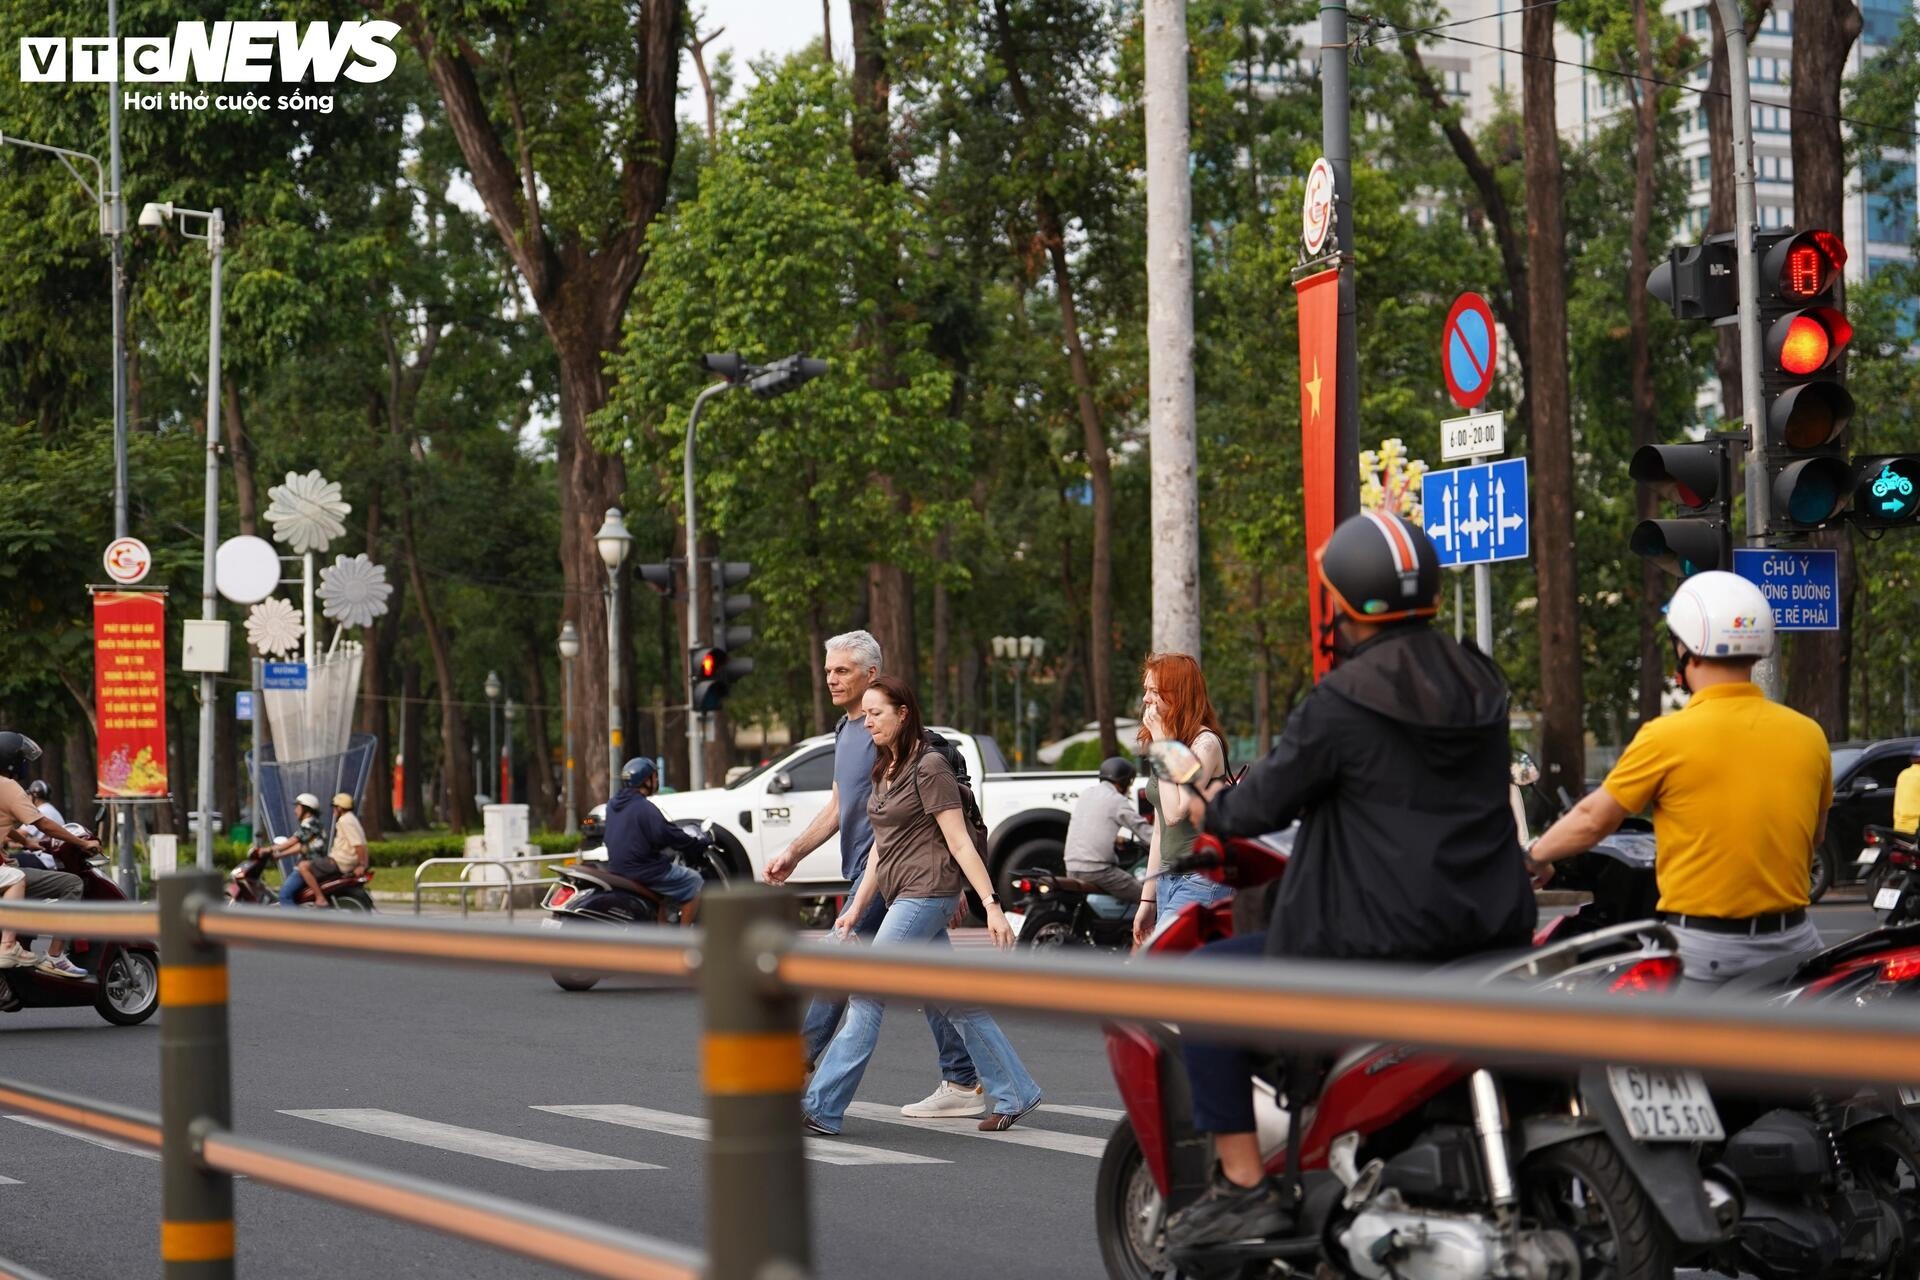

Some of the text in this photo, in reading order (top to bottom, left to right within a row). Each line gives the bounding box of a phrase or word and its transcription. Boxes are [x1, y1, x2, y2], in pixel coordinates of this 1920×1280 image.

[1763, 556, 1810, 576] CHÚ Ý
[1792, 580, 1831, 600] ĐƯỜNG
[1785, 605, 1800, 623] RẼ
[1802, 603, 1828, 624] PHẢI
